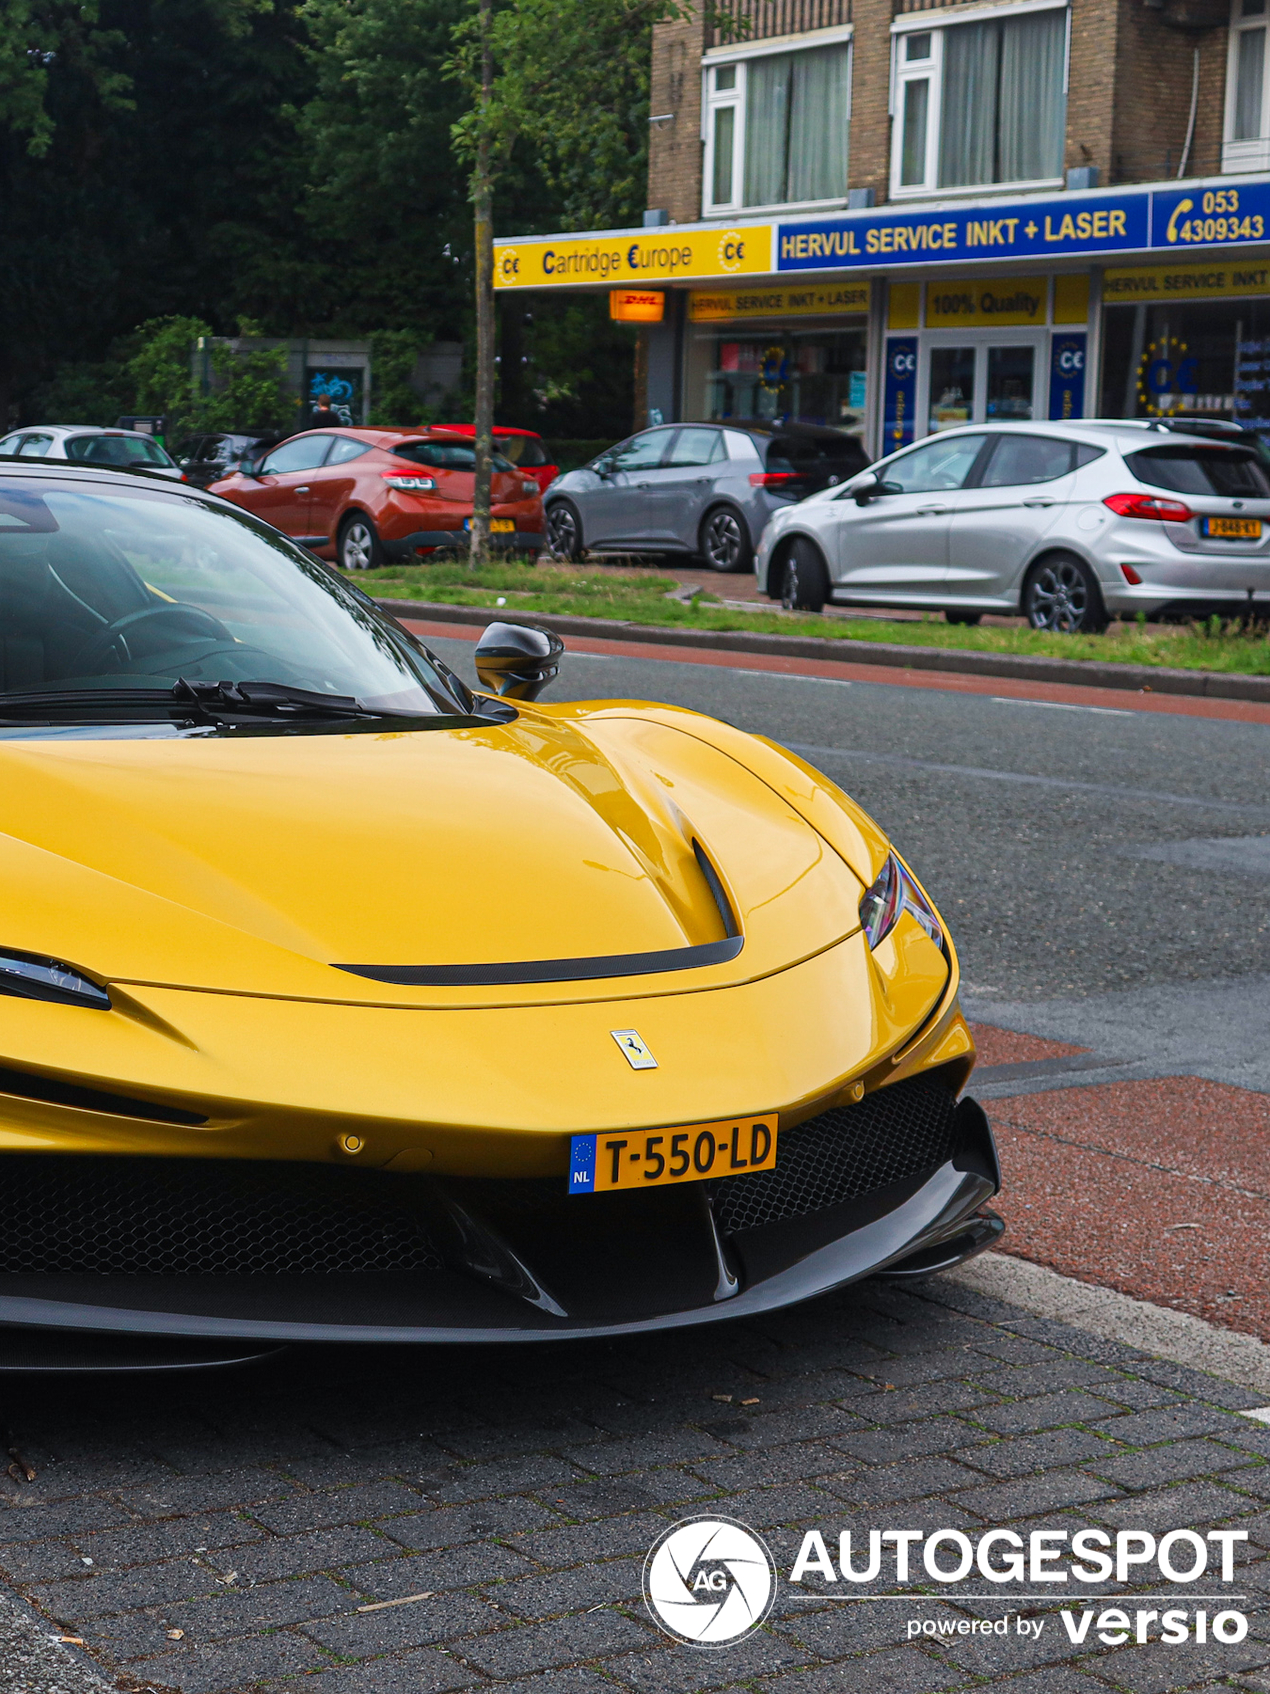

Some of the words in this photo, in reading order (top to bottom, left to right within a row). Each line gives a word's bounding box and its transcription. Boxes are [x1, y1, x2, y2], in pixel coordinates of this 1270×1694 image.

[1202, 189, 1239, 214] 053
[781, 231, 861, 259] HERVUL
[865, 223, 958, 254] SERVICE
[966, 218, 1019, 247] INKT
[1024, 221, 1038, 239] +
[1044, 209, 1127, 241] LASER
[1180, 215, 1264, 242] 4309343
[543, 247, 621, 277] Cartridge
[1164, 271, 1226, 291] SERVICE
[736, 294, 783, 310] SERVICE
[788, 292, 815, 307] INKT
[827, 290, 867, 306] LASER
[933, 294, 976, 314] 100%
[981, 292, 1041, 317] Quality
[606, 1123, 772, 1183] T-550-LD
[573, 1170, 590, 1184] NL
